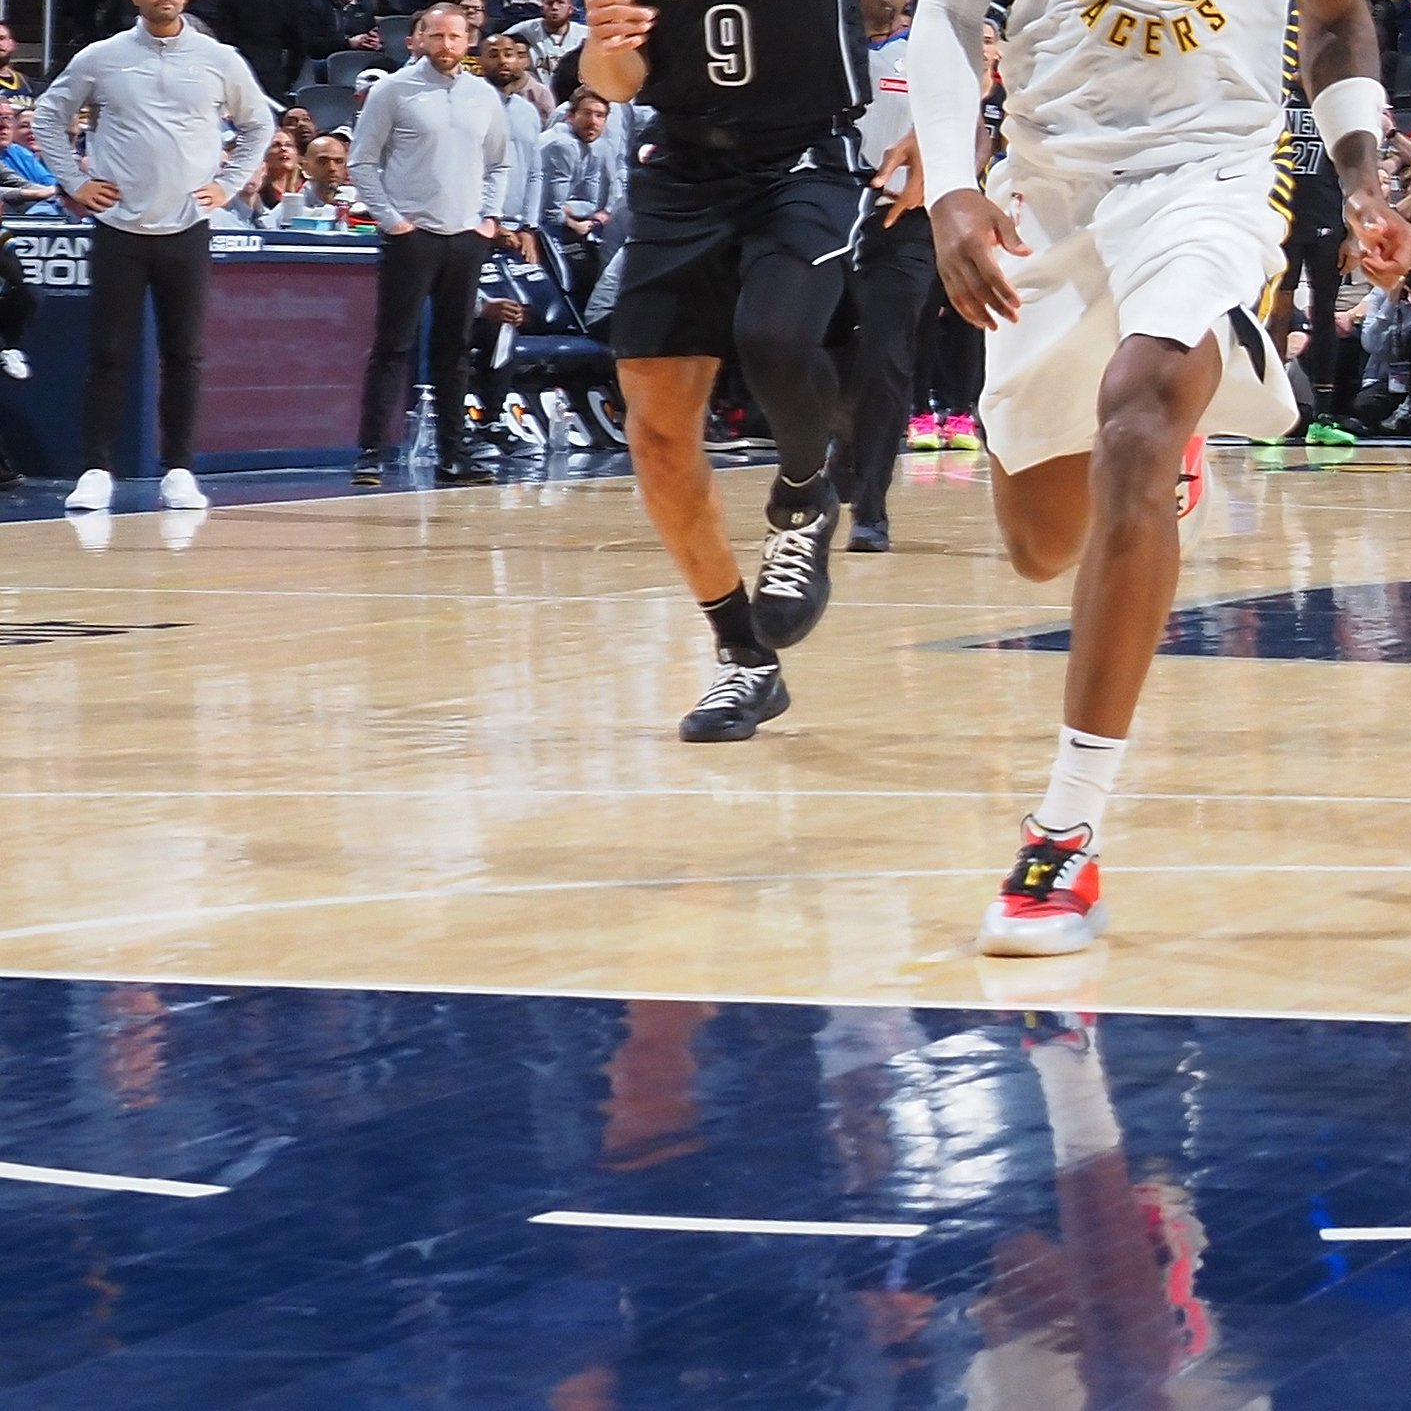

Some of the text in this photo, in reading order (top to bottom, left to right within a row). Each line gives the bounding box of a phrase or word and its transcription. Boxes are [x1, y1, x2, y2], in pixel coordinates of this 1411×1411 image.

[704, 3, 754, 87] 9
[1284, 109, 1317, 138] NE
[1291, 141, 1323, 175] 27
[16, 236, 91, 257] DIAN
[22, 259, 91, 286] BOL
